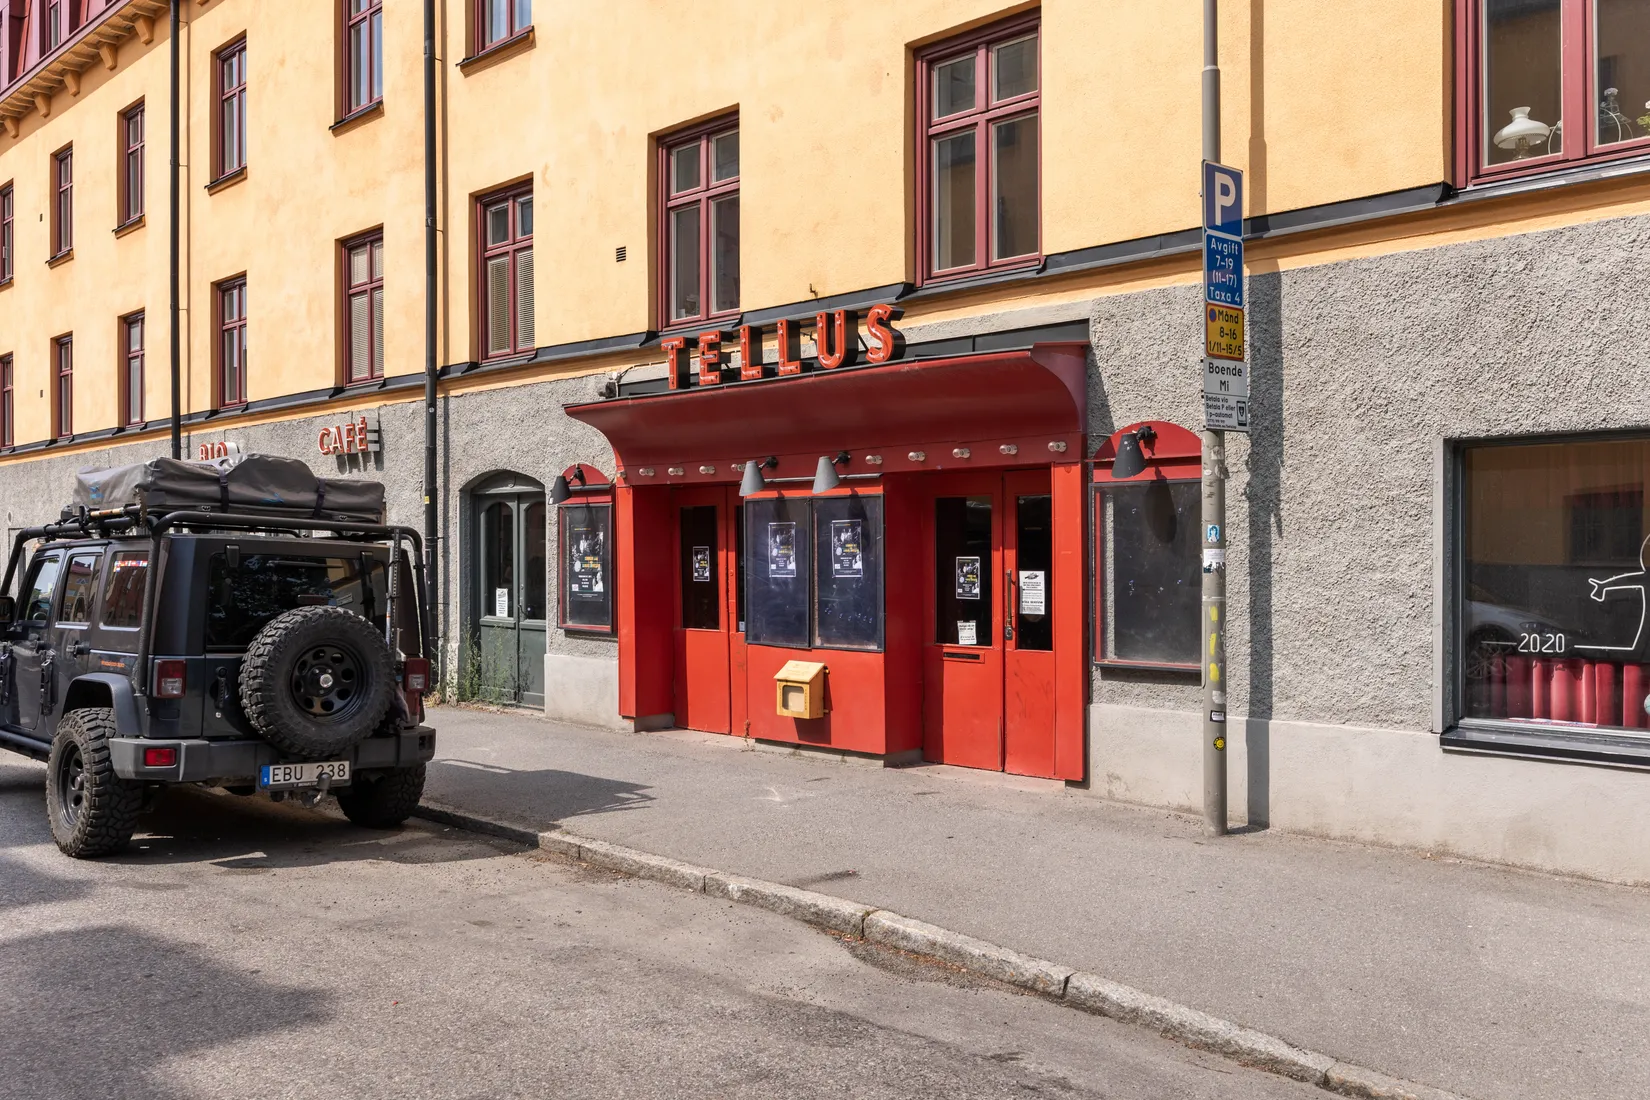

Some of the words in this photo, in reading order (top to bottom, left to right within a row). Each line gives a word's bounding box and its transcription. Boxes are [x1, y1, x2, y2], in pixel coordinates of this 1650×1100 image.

[1215, 171, 1236, 226] P
[1210, 237, 1239, 255] Avgift
[1215, 254, 1234, 270] 7-19
[1212, 269, 1237, 288] (11-17)
[1209, 286, 1232, 302] Taxa
[1234, 292, 1241, 304] 4
[1217, 309, 1239, 325] Månd
[1219, 326, 1238, 340] 8-16
[661, 303, 906, 390] TELLUS
[1208, 340, 1243, 356] 1/11-15/5
[1208, 361, 1243, 377] Boende
[1219, 379, 1230, 392] Mi
[1209, 411, 1233, 419] p-automat
[1225, 404, 1236, 412] eller
[318, 416, 368, 456] CAFÉ
[1517, 633, 1565, 653] 2020
[272, 765, 303, 783] EBU
[316, 763, 346, 779] 238
